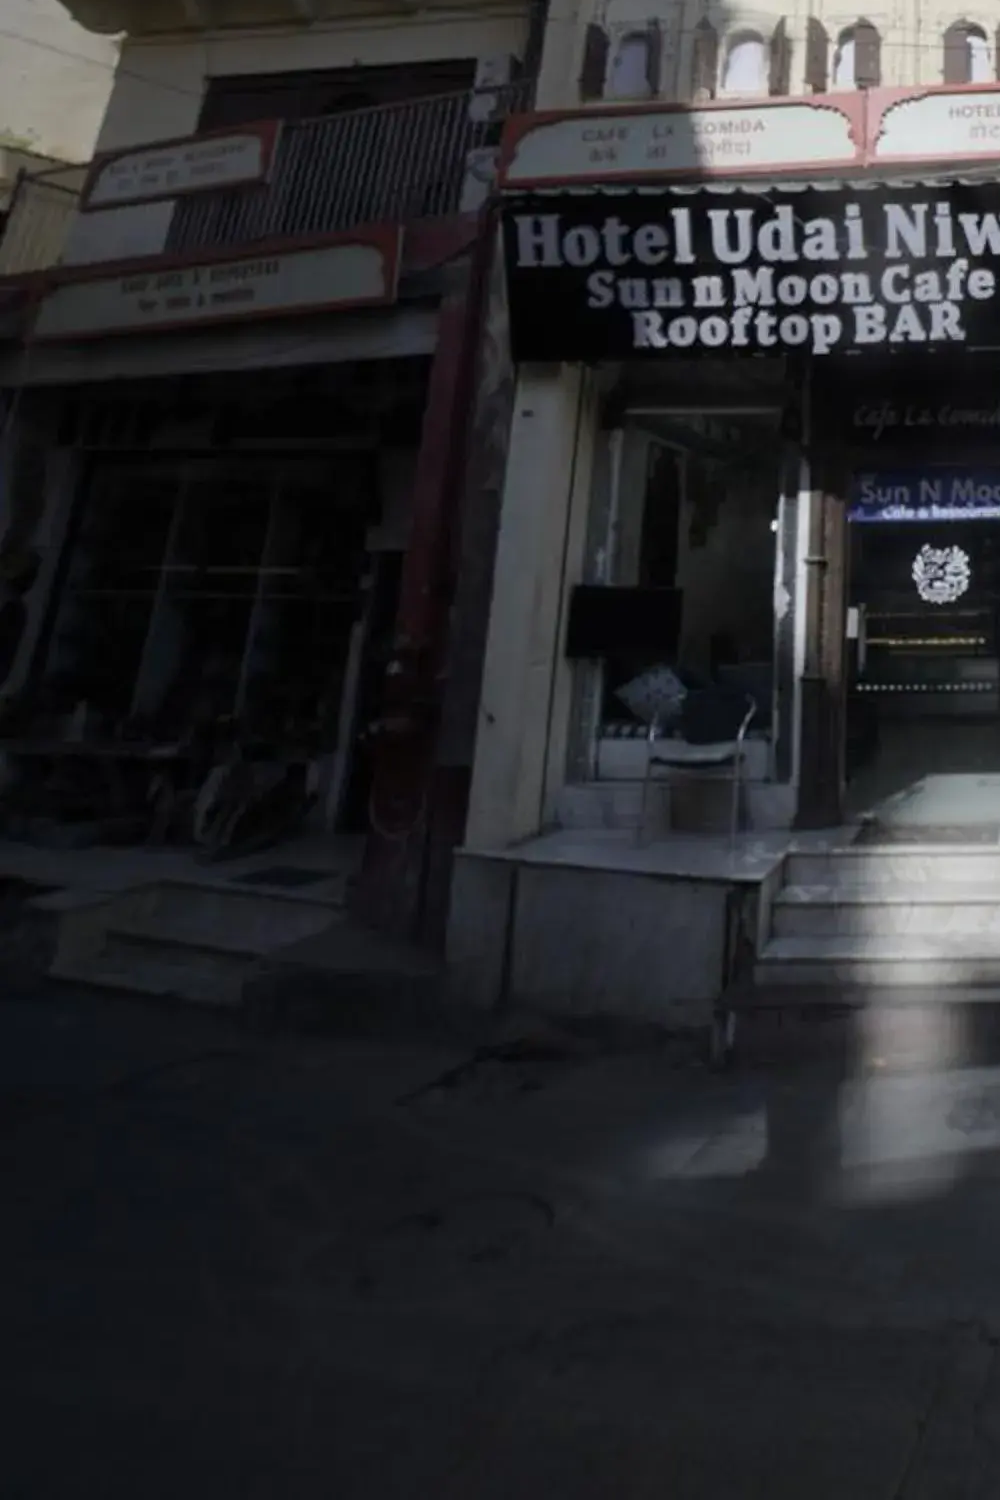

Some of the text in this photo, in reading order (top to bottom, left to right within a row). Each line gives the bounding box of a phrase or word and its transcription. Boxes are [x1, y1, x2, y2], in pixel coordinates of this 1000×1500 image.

[581, 126, 630, 142] CAFE
[513, 208, 693, 267] Hotel
[710, 204, 868, 265] Udai
[587, 270, 684, 308] Sun
[732, 266, 872, 306] Moon
[878, 260, 996, 303] Cafe
[631, 304, 966, 353] Rooftop BAR
[853, 399, 899, 441] Cafe
[860, 477, 910, 505] Sun
[920, 477, 942, 503] N
